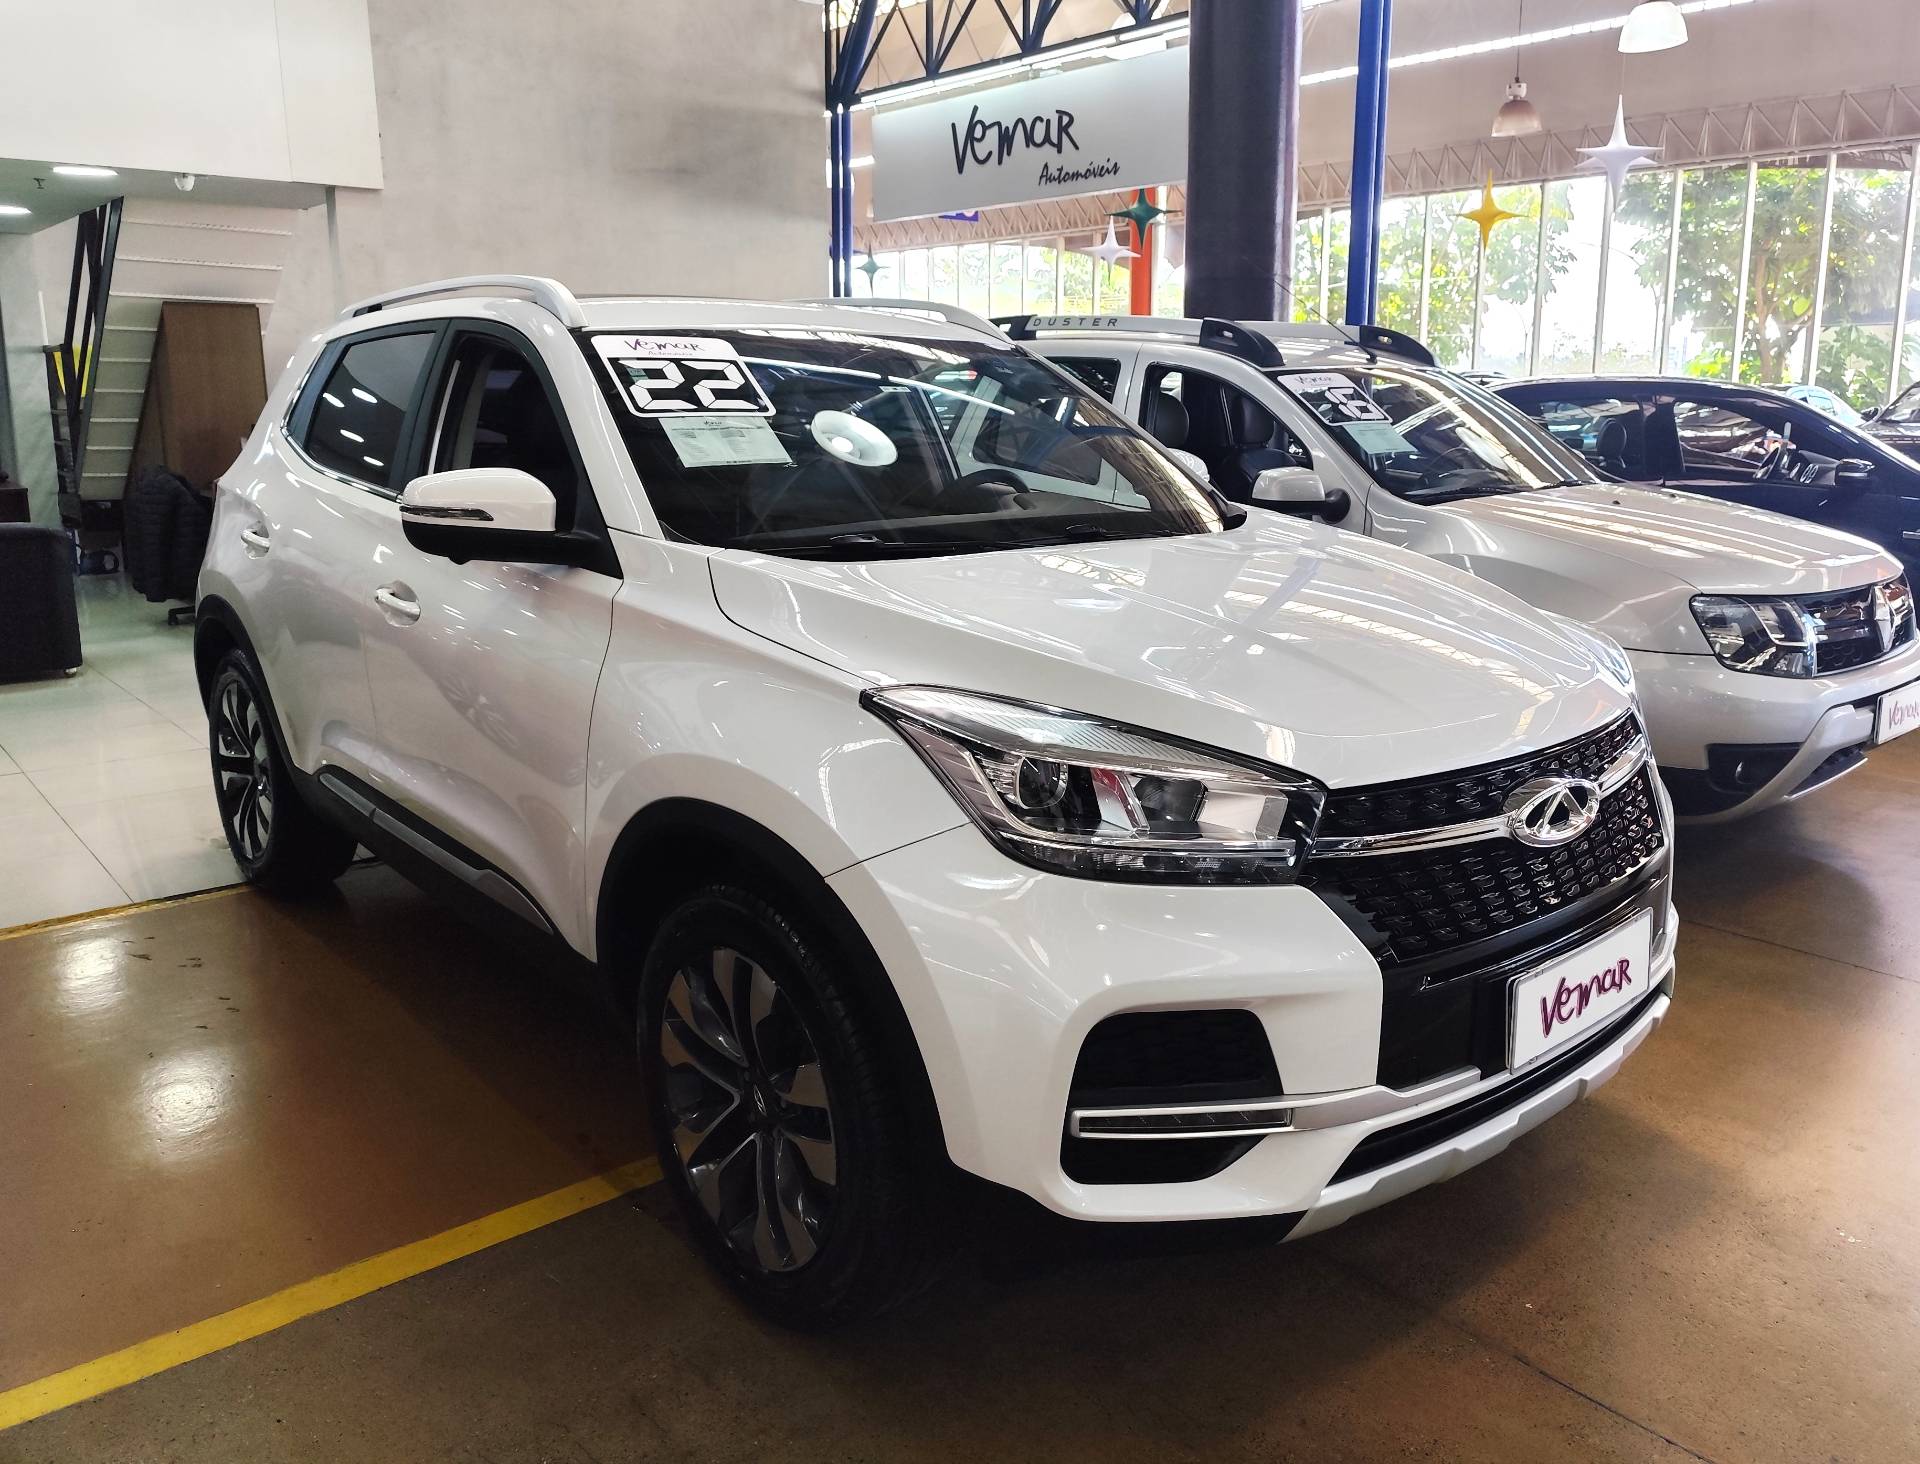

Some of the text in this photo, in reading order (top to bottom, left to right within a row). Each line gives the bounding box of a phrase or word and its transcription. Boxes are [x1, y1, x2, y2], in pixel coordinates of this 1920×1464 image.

[1038, 157, 1121, 186] Automóveis
[1033, 317, 1118, 327] DUSTER
[617, 360, 760, 410] 22
[1324, 387, 1386, 420] 16
